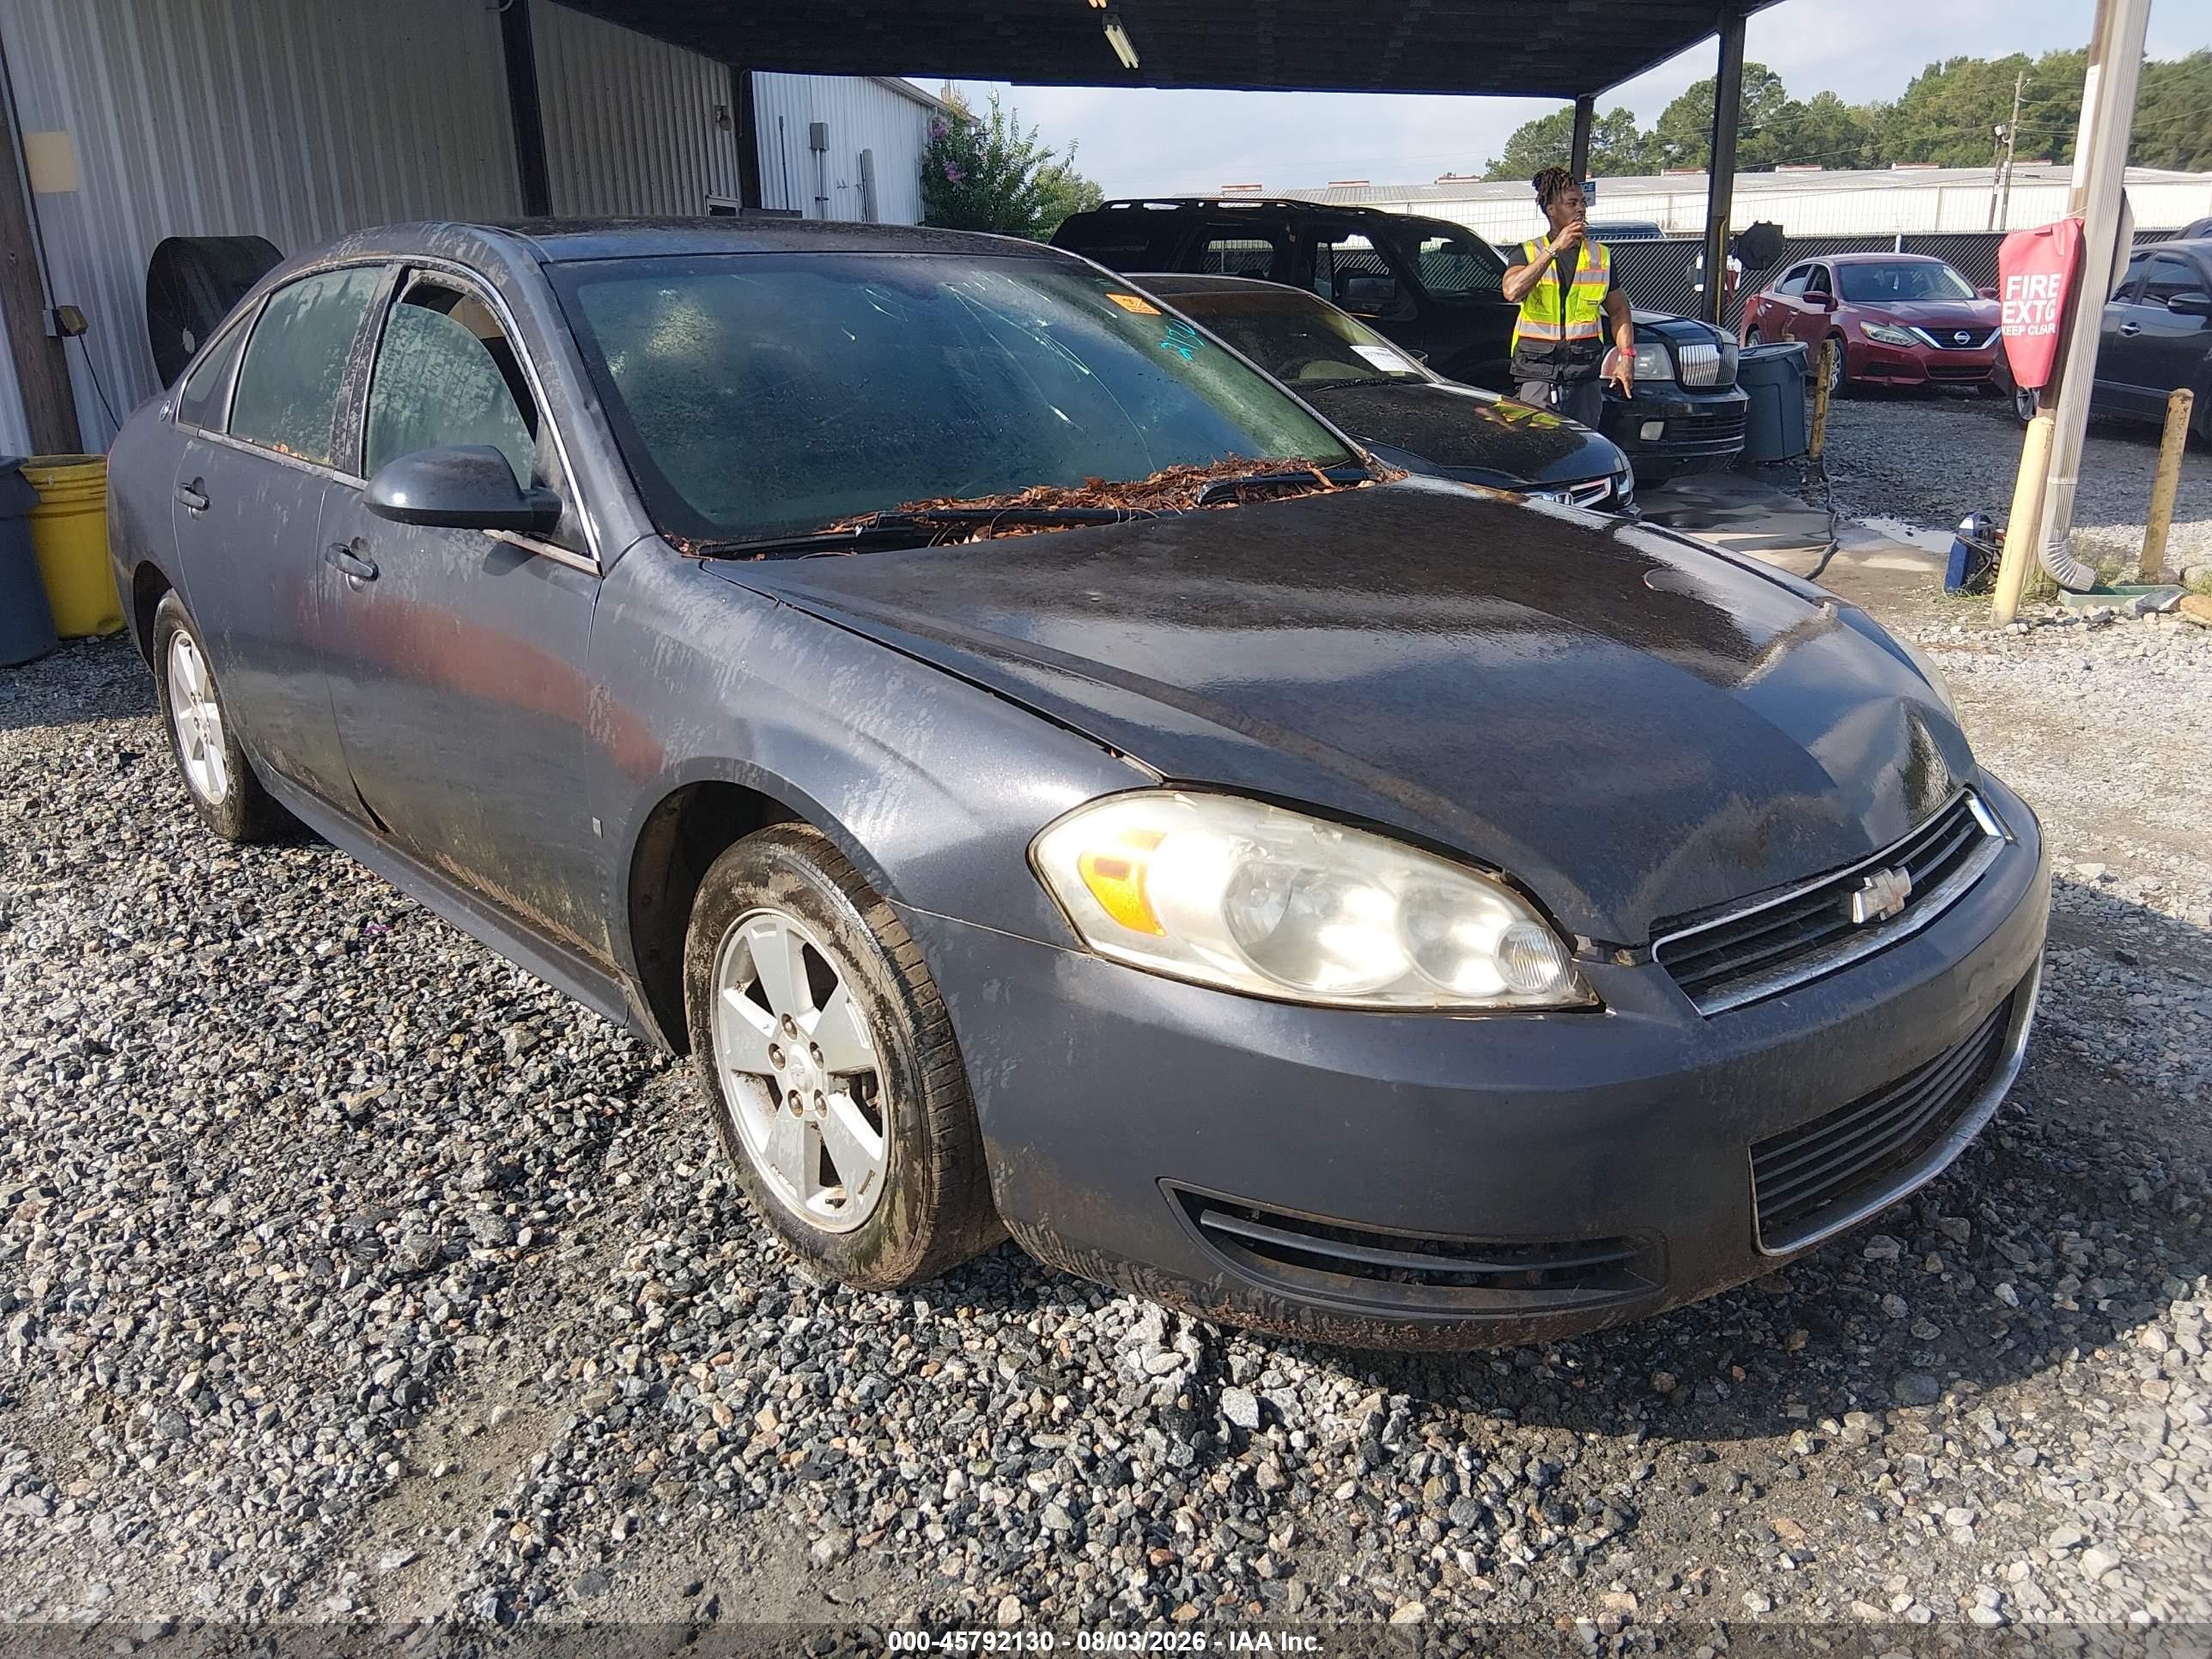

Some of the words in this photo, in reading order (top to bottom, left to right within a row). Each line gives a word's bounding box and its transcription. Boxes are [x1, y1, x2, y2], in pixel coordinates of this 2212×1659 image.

[2006, 274, 2061, 300] FIRE
[2002, 298, 2056, 324] EXTG
[2002, 325, 2026, 337] KEEP
[2027, 323, 2055, 336] CLEAR
